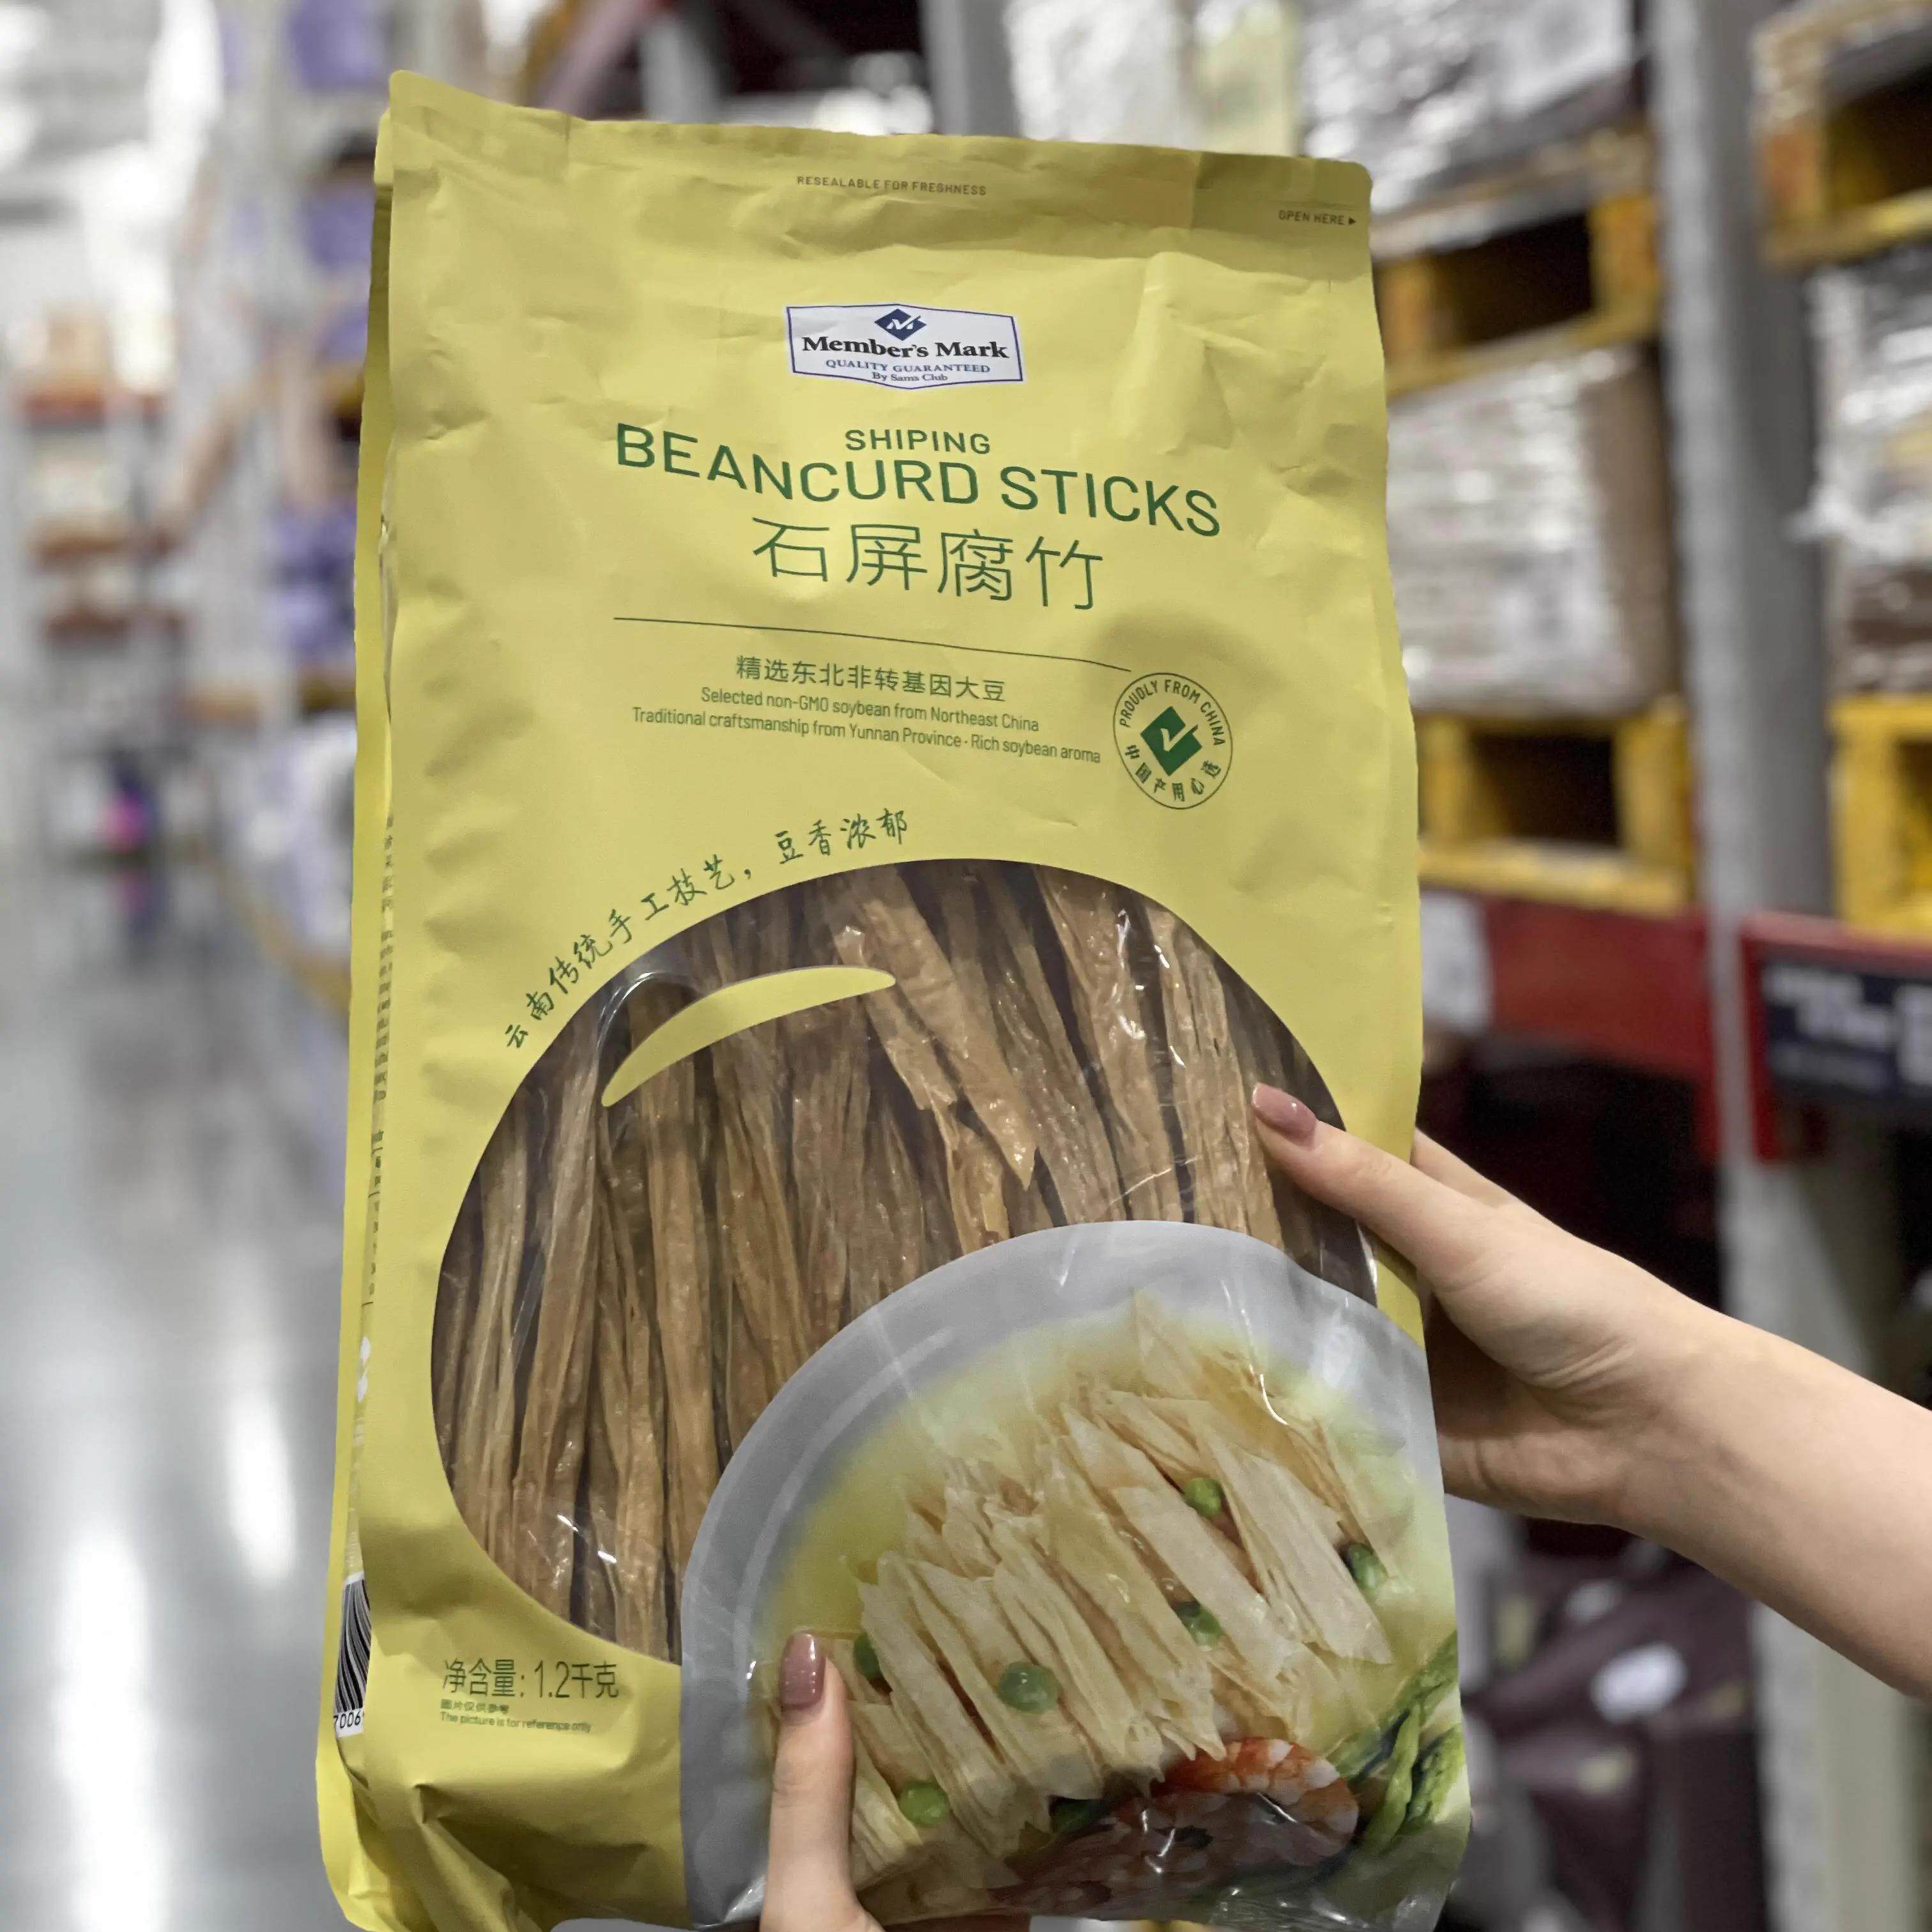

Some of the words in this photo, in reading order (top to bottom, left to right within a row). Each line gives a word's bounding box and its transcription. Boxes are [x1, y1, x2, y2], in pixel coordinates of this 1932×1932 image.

[797, 176, 880, 189] RESEALABLE
[884, 180, 908, 190] FOR
[912, 181, 986, 195] FRESHNESS
[1278, 210, 1310, 222] OPEN
[1314, 213, 1345, 226] HERE
[801, 335, 929, 358] Member's
[935, 341, 1010, 358] Mark
[825, 358, 888, 372] QUALITY
[893, 364, 991, 374] GUARANTEED
[872, 371, 887, 382] By
[922, 372, 948, 382] Club
[845, 428, 991, 456] SHIPING
[617, 422, 979, 504] BEANCURD
[1000, 464, 1221, 538] STICKS
[752, 517, 1103, 610] 石屏腐竹
[736, 655, 1006, 702] 精选东北非转基因大豆
[701, 686, 763, 707] Selected
[766, 694, 829, 712] non-GMO
[832, 701, 890, 719] soybean
[894, 702, 927, 721] from
[930, 706, 999, 728] Northeast
[1002, 713, 1039, 732] China
[1119, 680, 1158, 728] PROUDLY
[1164, 678, 1201, 704] FROM
[1200, 701, 1226, 746] CHINA
[632, 706, 706, 726] Traditional
[709, 713, 809, 737] craftsmanship
[813, 720, 845, 738] from
[849, 723, 899, 742] Yunnan
[902, 728, 962, 748] Province
[971, 733, 999, 751] Rich
[1002, 739, 1057, 758] soybean
[1061, 748, 1101, 763] aroma
